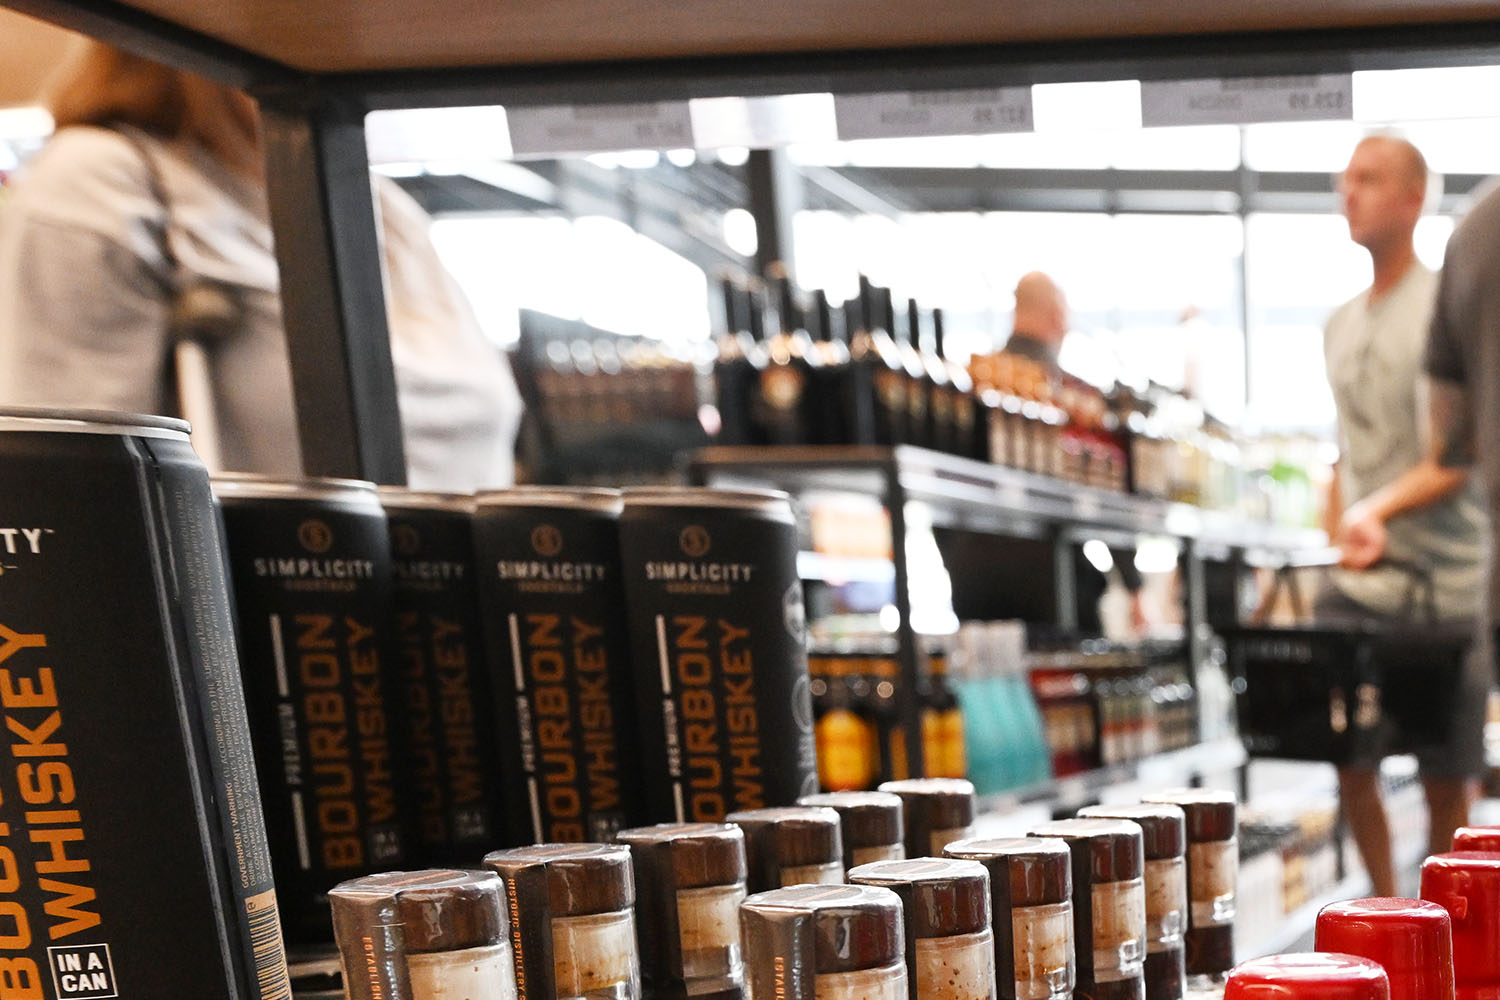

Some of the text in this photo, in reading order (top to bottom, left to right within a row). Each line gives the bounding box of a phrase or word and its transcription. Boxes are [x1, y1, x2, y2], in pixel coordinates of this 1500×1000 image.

[254, 557, 373, 579] SIMPLICITY
[497, 561, 604, 581] SIMPLICITY
[645, 561, 751, 582] SIMPLICITY
[0, 624, 101, 940] WHISKEY
[295, 614, 364, 870] BOURBON
[345, 617, 396, 824] WHISKEY
[527, 613, 585, 843] BOURBON
[569, 616, 620, 811] WHISKEY
[673, 615, 727, 824] OURBON
[717, 618, 764, 811] WHISKEY
[57, 951, 103, 973] IN A
[61, 972, 108, 992] CAN
